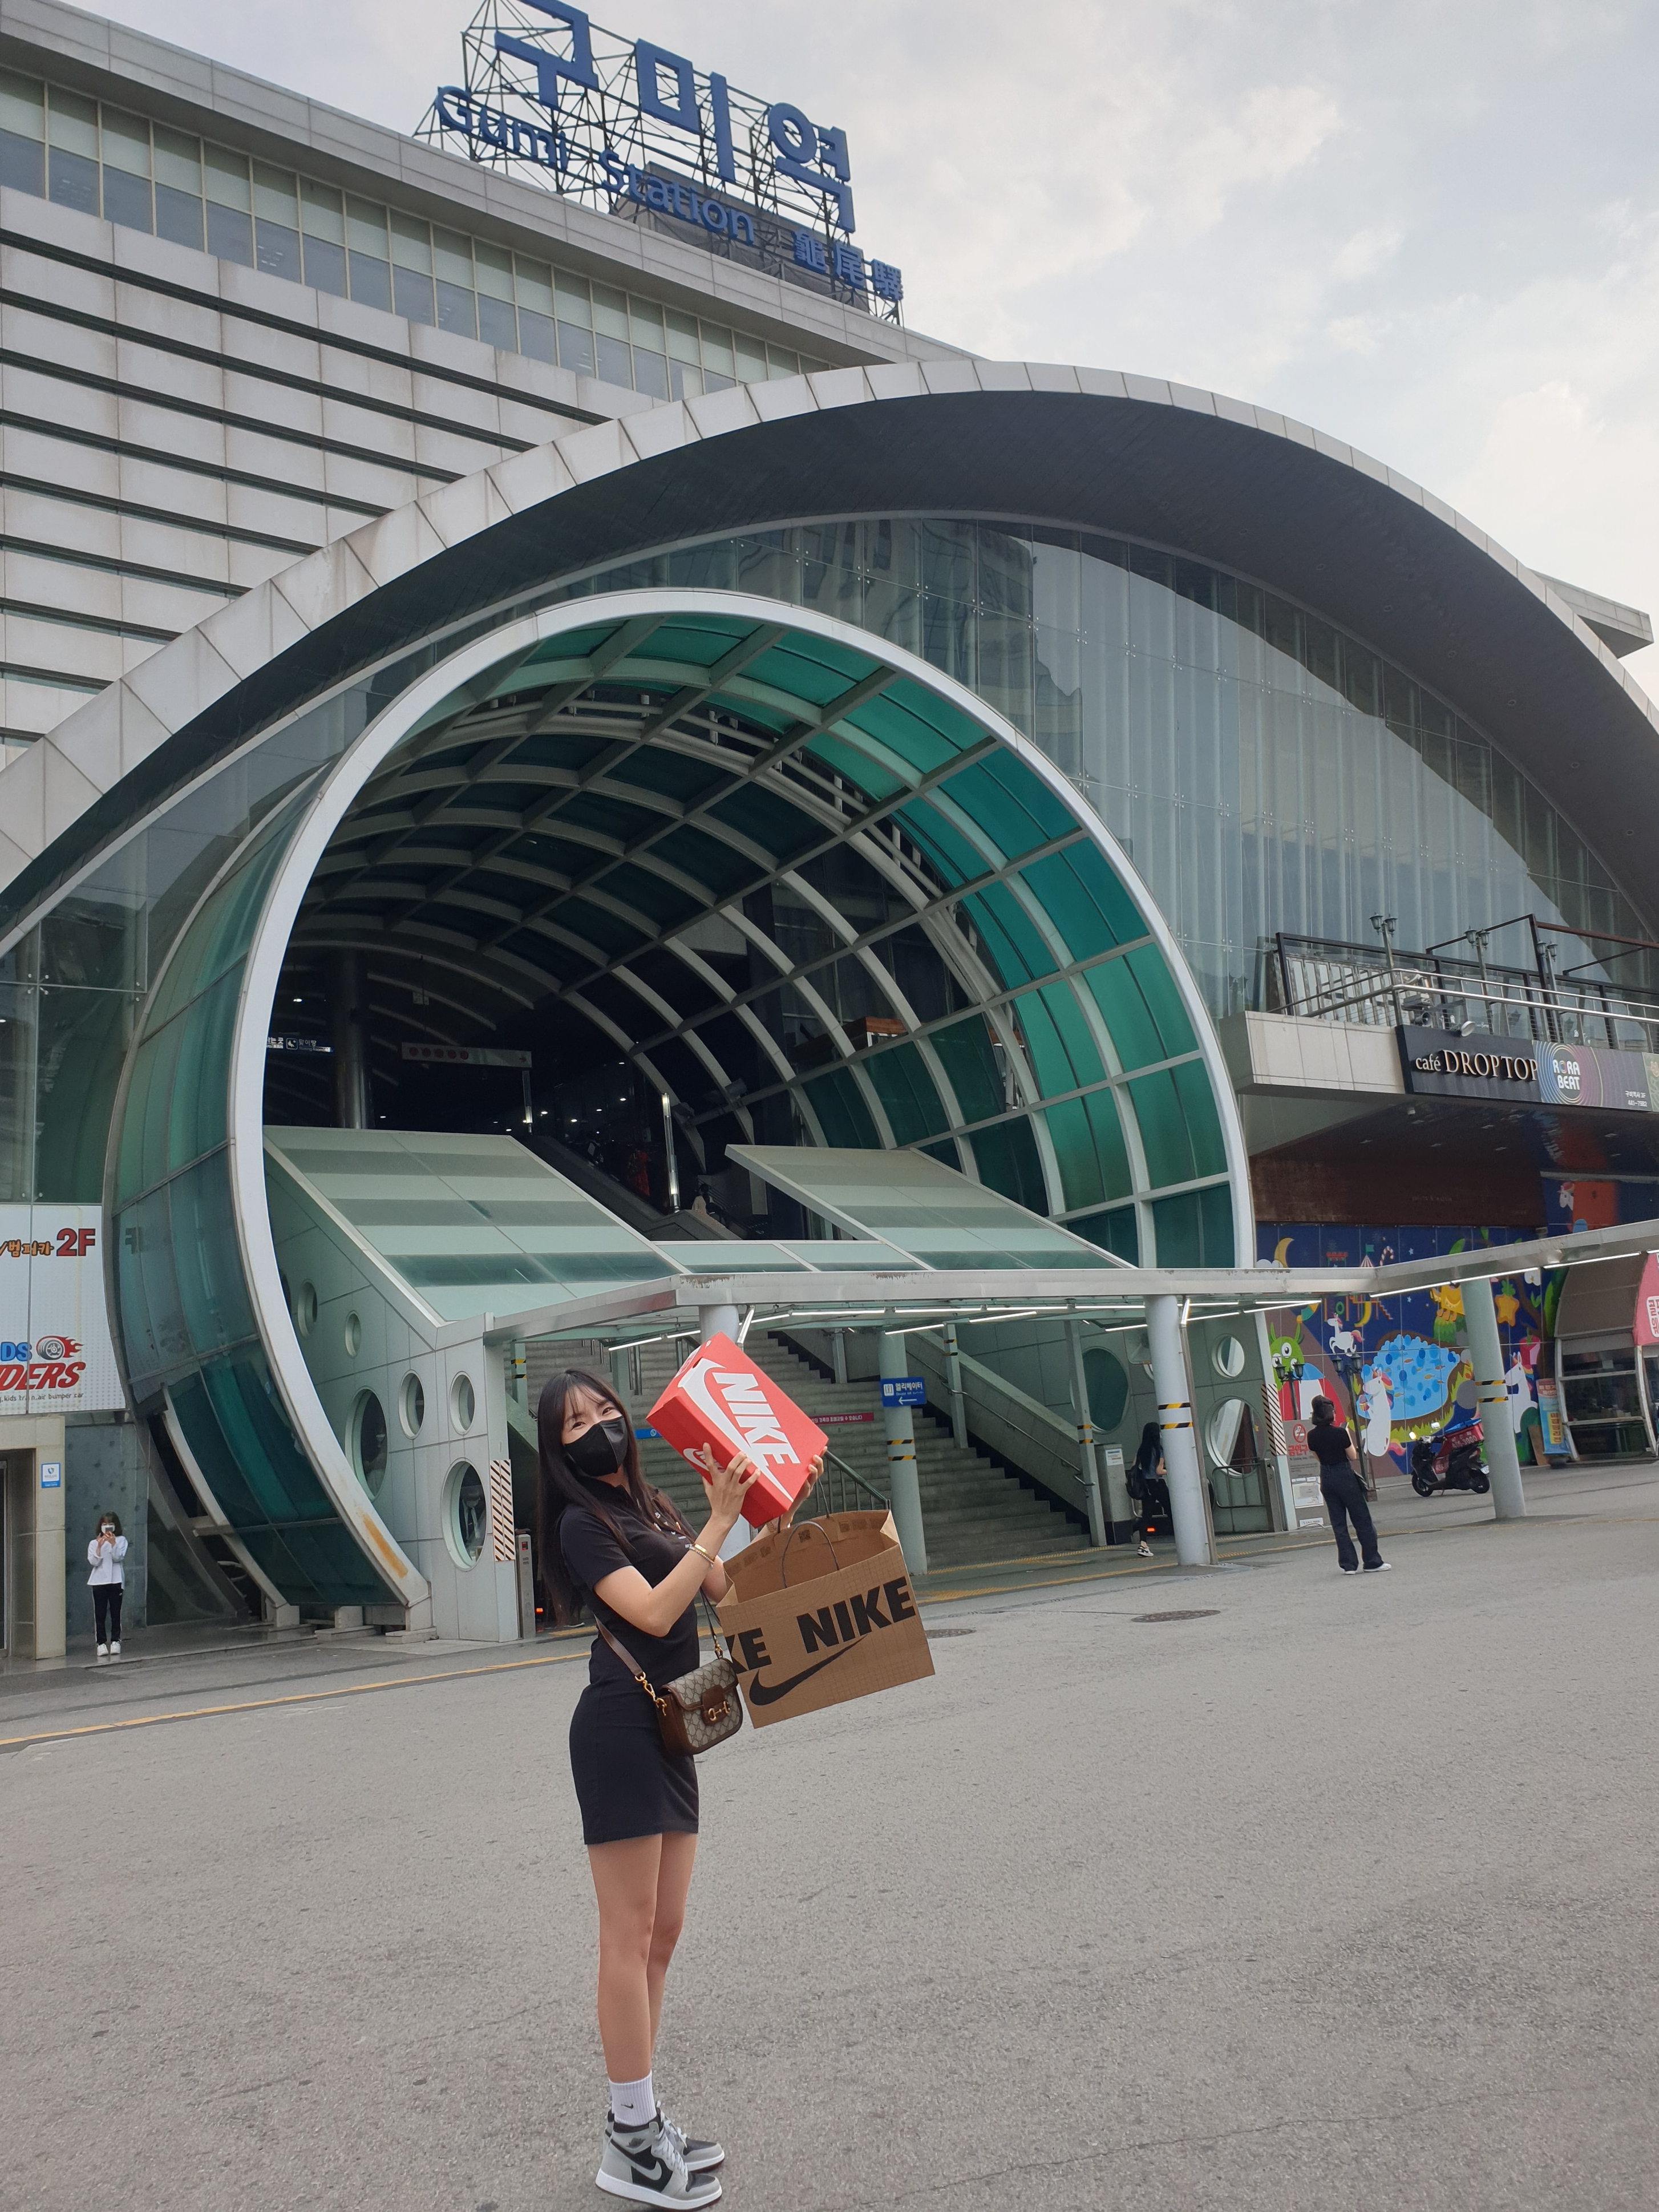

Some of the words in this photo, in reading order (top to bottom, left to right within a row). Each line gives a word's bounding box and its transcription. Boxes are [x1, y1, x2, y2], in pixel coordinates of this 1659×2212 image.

[494, 0, 856, 233] 구미역
[434, 85, 569, 171] Gumi
[598, 148, 755, 246] Station
[1415, 1053, 1442, 1071] café
[1442, 1049, 1539, 1081] DROPTOP
[1552, 1059, 1581, 1075] RORA
[1557, 1075, 1580, 1090] BEAT
[56, 1228, 96, 1256] 2F
[0, 1341, 33, 1361] DS
[712, 1372, 800, 1466] NIKE
[1288, 1444, 1311, 1457] 금연구
[796, 1576, 916, 1654] NIKE
